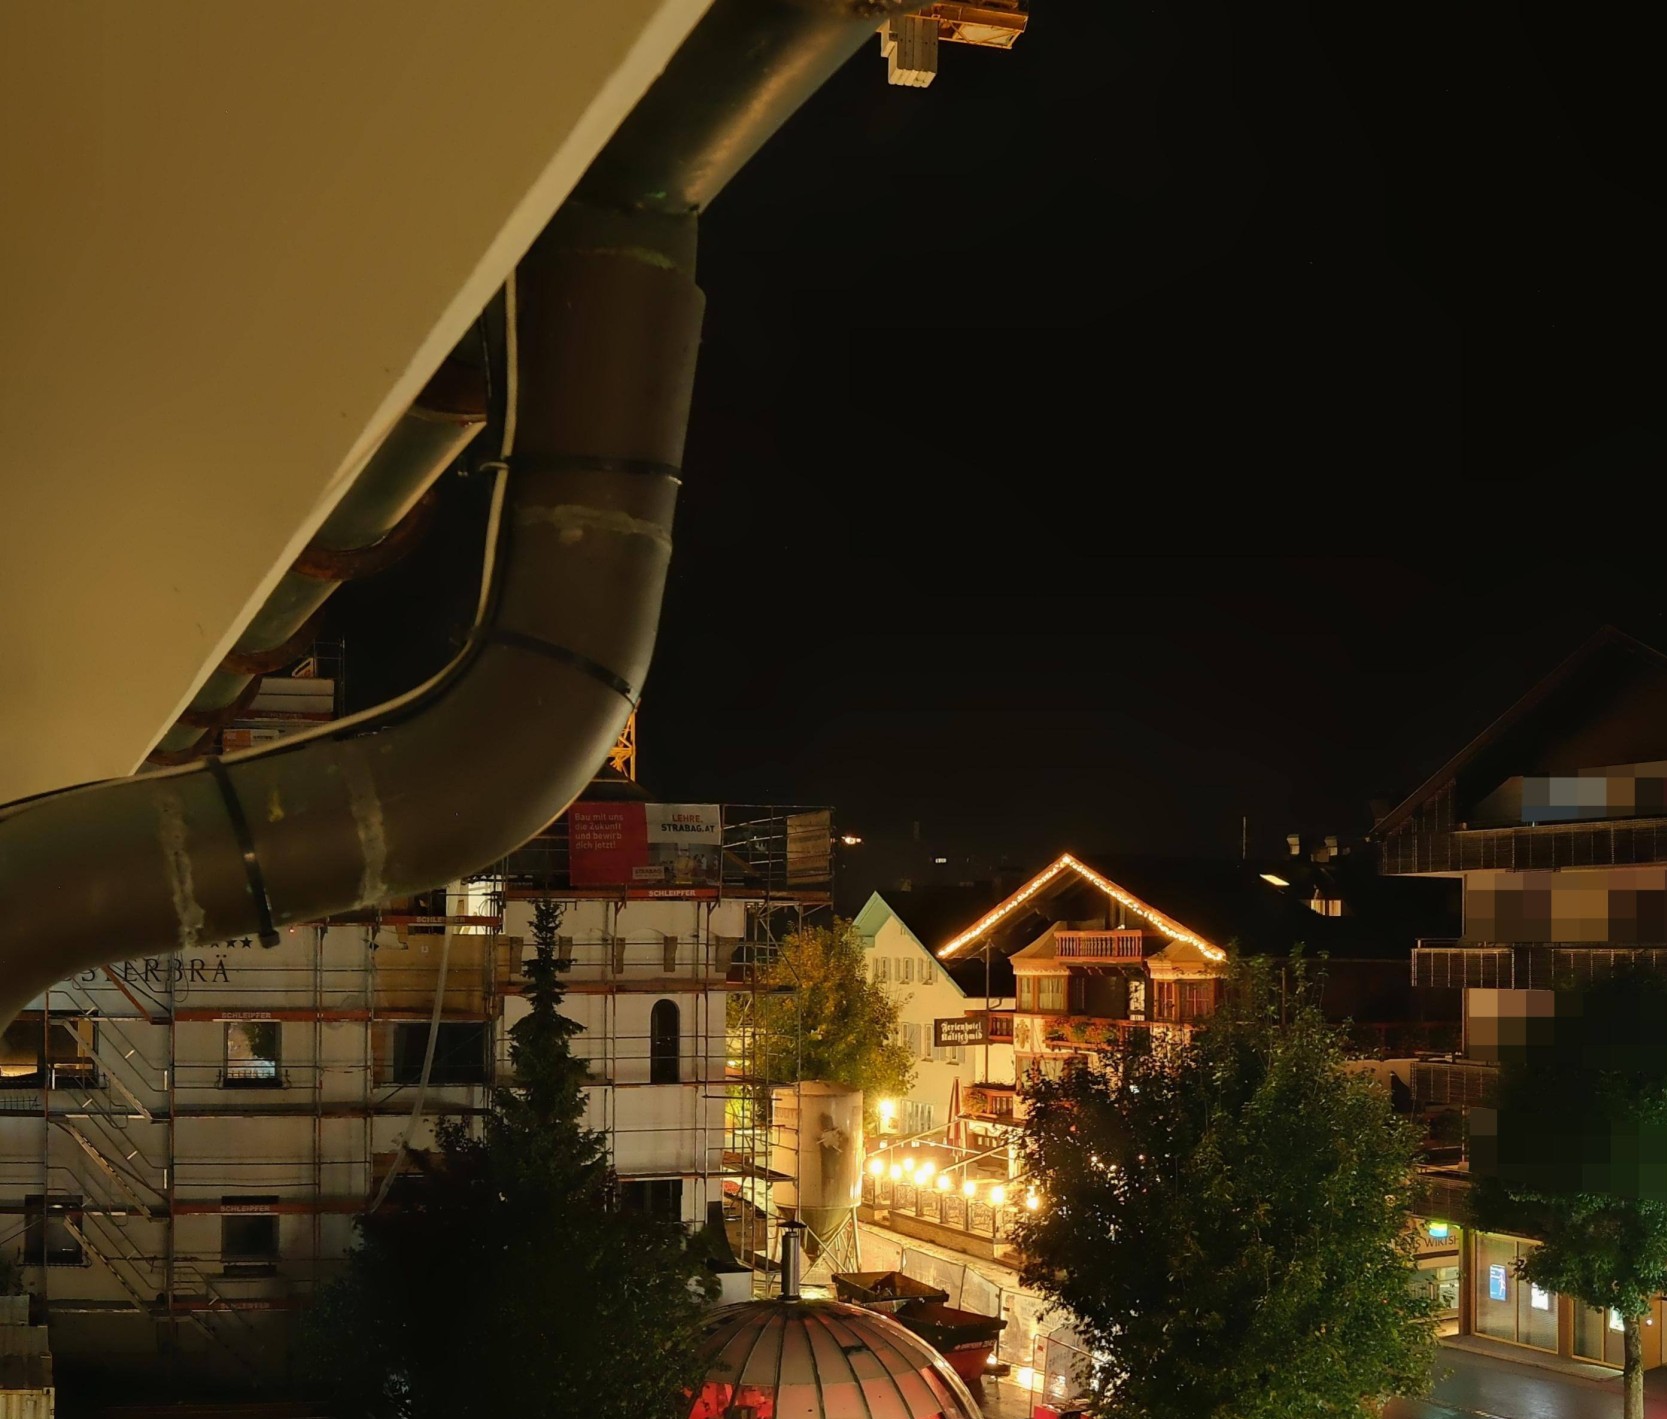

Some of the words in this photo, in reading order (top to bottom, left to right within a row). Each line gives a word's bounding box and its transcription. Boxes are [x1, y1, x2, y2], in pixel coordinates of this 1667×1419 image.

[575, 813, 591, 821] Bau
[592, 813, 606, 821] mit
[672, 814, 703, 823] LEHRE.
[661, 824, 715, 833] STRABAG.AT
[575, 832, 591, 840] und
[593, 832, 622, 840] bewirb
[575, 841, 592, 849] dich
[649, 889, 696, 897] SCHLEIPFER
